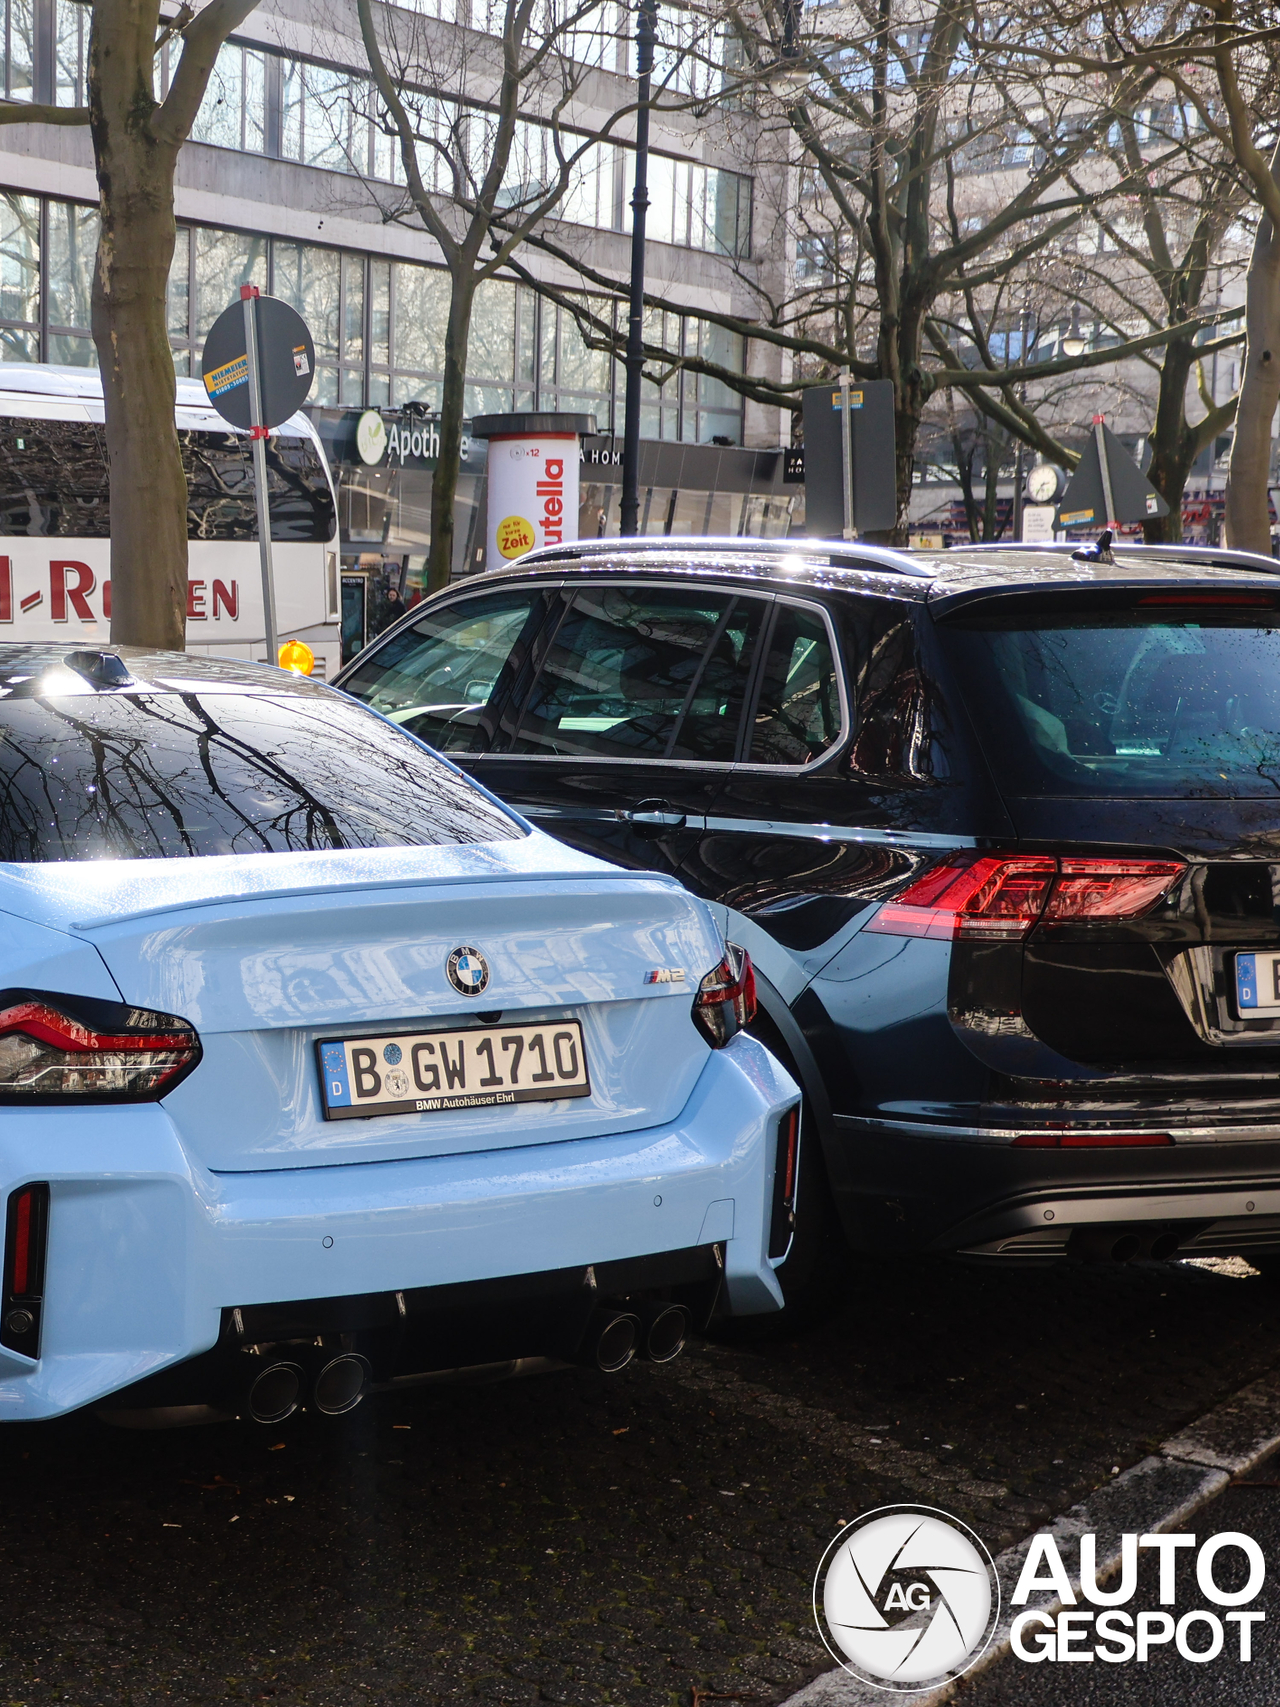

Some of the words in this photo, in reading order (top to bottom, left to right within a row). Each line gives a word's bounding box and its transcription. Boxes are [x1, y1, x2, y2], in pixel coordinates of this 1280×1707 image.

[212, 359, 248, 382] NIEMEIER
[388, 423, 468, 466] Apothe
[591, 449, 620, 466] HOM
[790, 458, 803, 466] ZA
[536, 459, 563, 547] utella
[502, 533, 529, 551] Zeit
[450, 947, 485, 964] BMW
[657, 968, 686, 983] M2
[1242, 987, 1251, 1000] D
[351, 1048, 381, 1098] B
[411, 1040, 467, 1091] GW
[476, 1032, 579, 1087] 1710
[333, 1081, 343, 1096] D
[416, 1098, 441, 1111] BMW
[443, 1095, 495, 1109] Autohäuser
[496, 1092, 515, 1105] Ehrl
